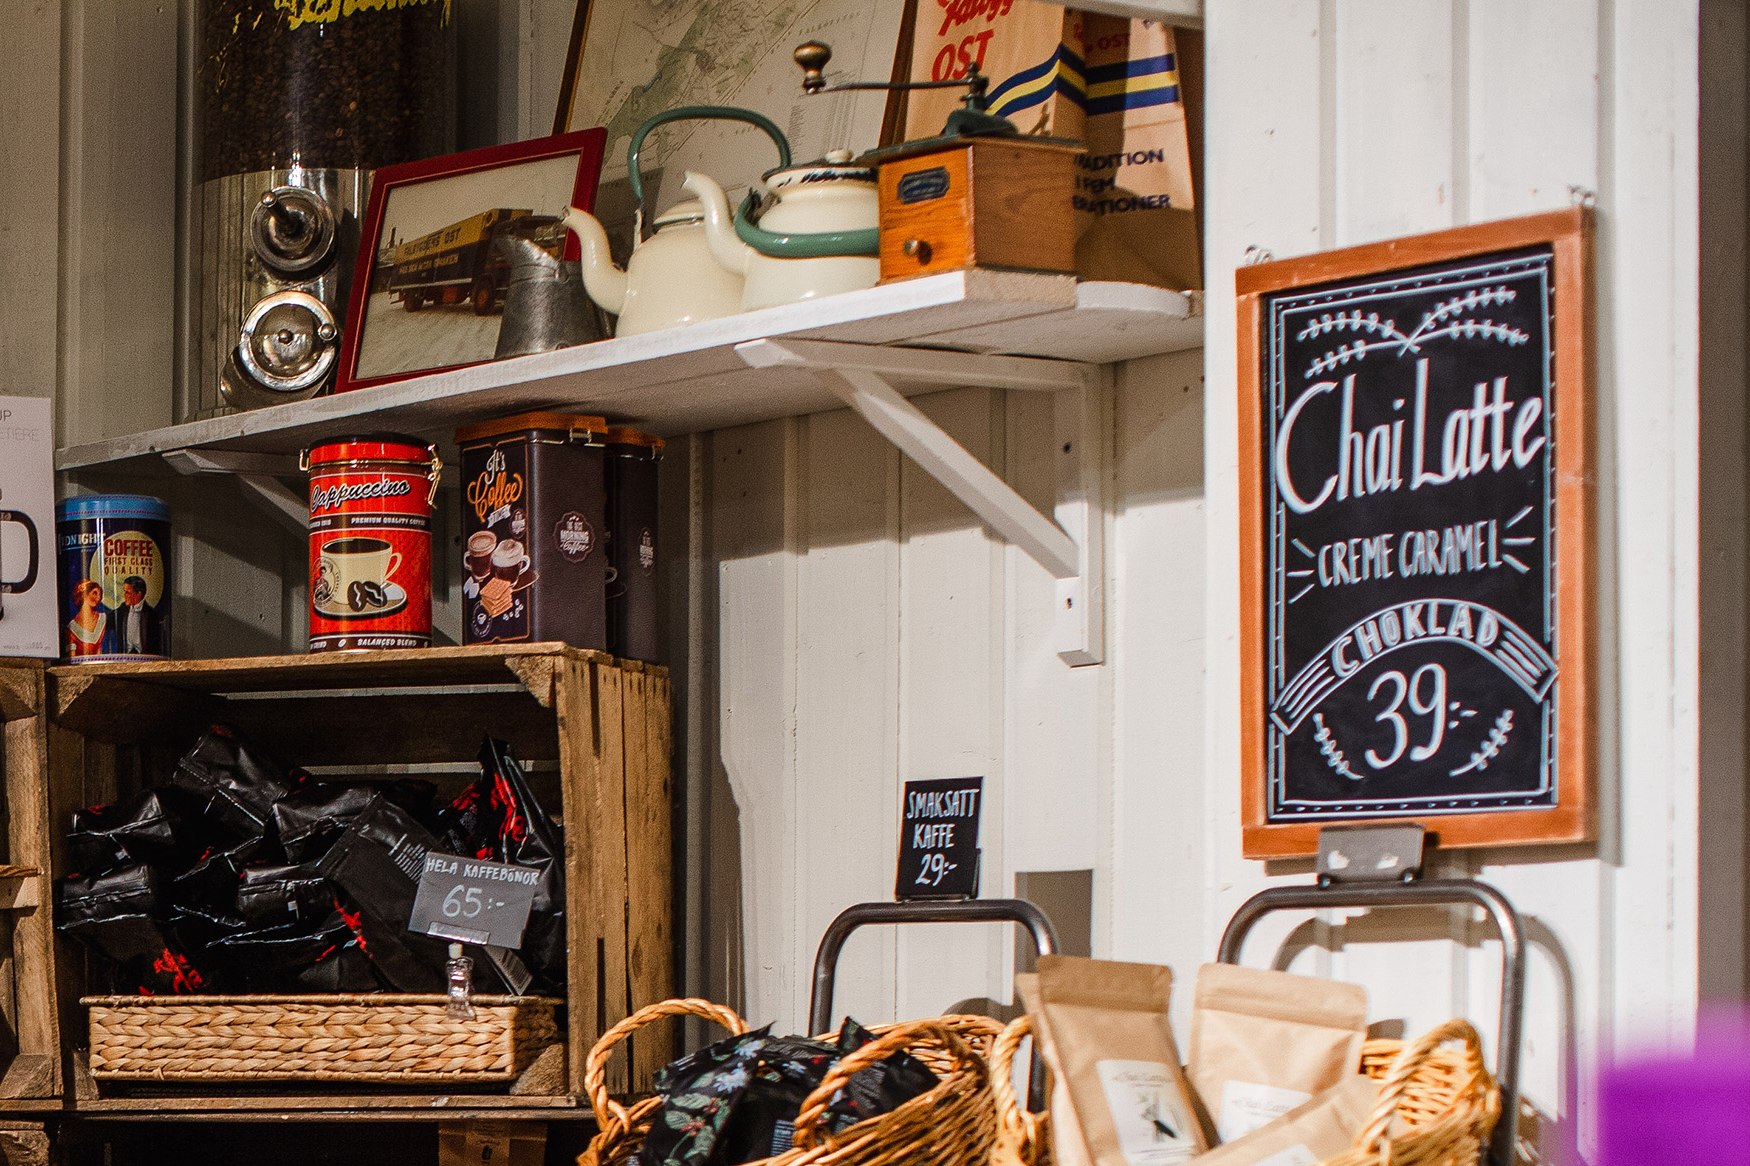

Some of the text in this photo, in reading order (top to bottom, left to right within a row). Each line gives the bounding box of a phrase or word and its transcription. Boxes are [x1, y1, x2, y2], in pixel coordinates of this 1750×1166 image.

[932, 29, 994, 82] OST
[1274, 357, 1547, 515] Chai Latte
[310, 478, 412, 514] Cappuccino
[466, 471, 524, 524] Coffee
[351, 517, 382, 525] PREMIUM
[383, 517, 408, 525] QUALITY
[104, 538, 154, 557] COFFEE
[104, 557, 153, 567] FIRST CLASS
[1317, 518, 1503, 588] CREME CARAMEL
[104, 566, 154, 576] QUALITY
[357, 638, 395, 647] BALANCED
[1332, 605, 1499, 680] CHOKLAD
[906, 789, 980, 819] SMAKSATT
[912, 824, 956, 849] KAFFE
[425, 857, 540, 886] HELA KAFFEBÖNOR
